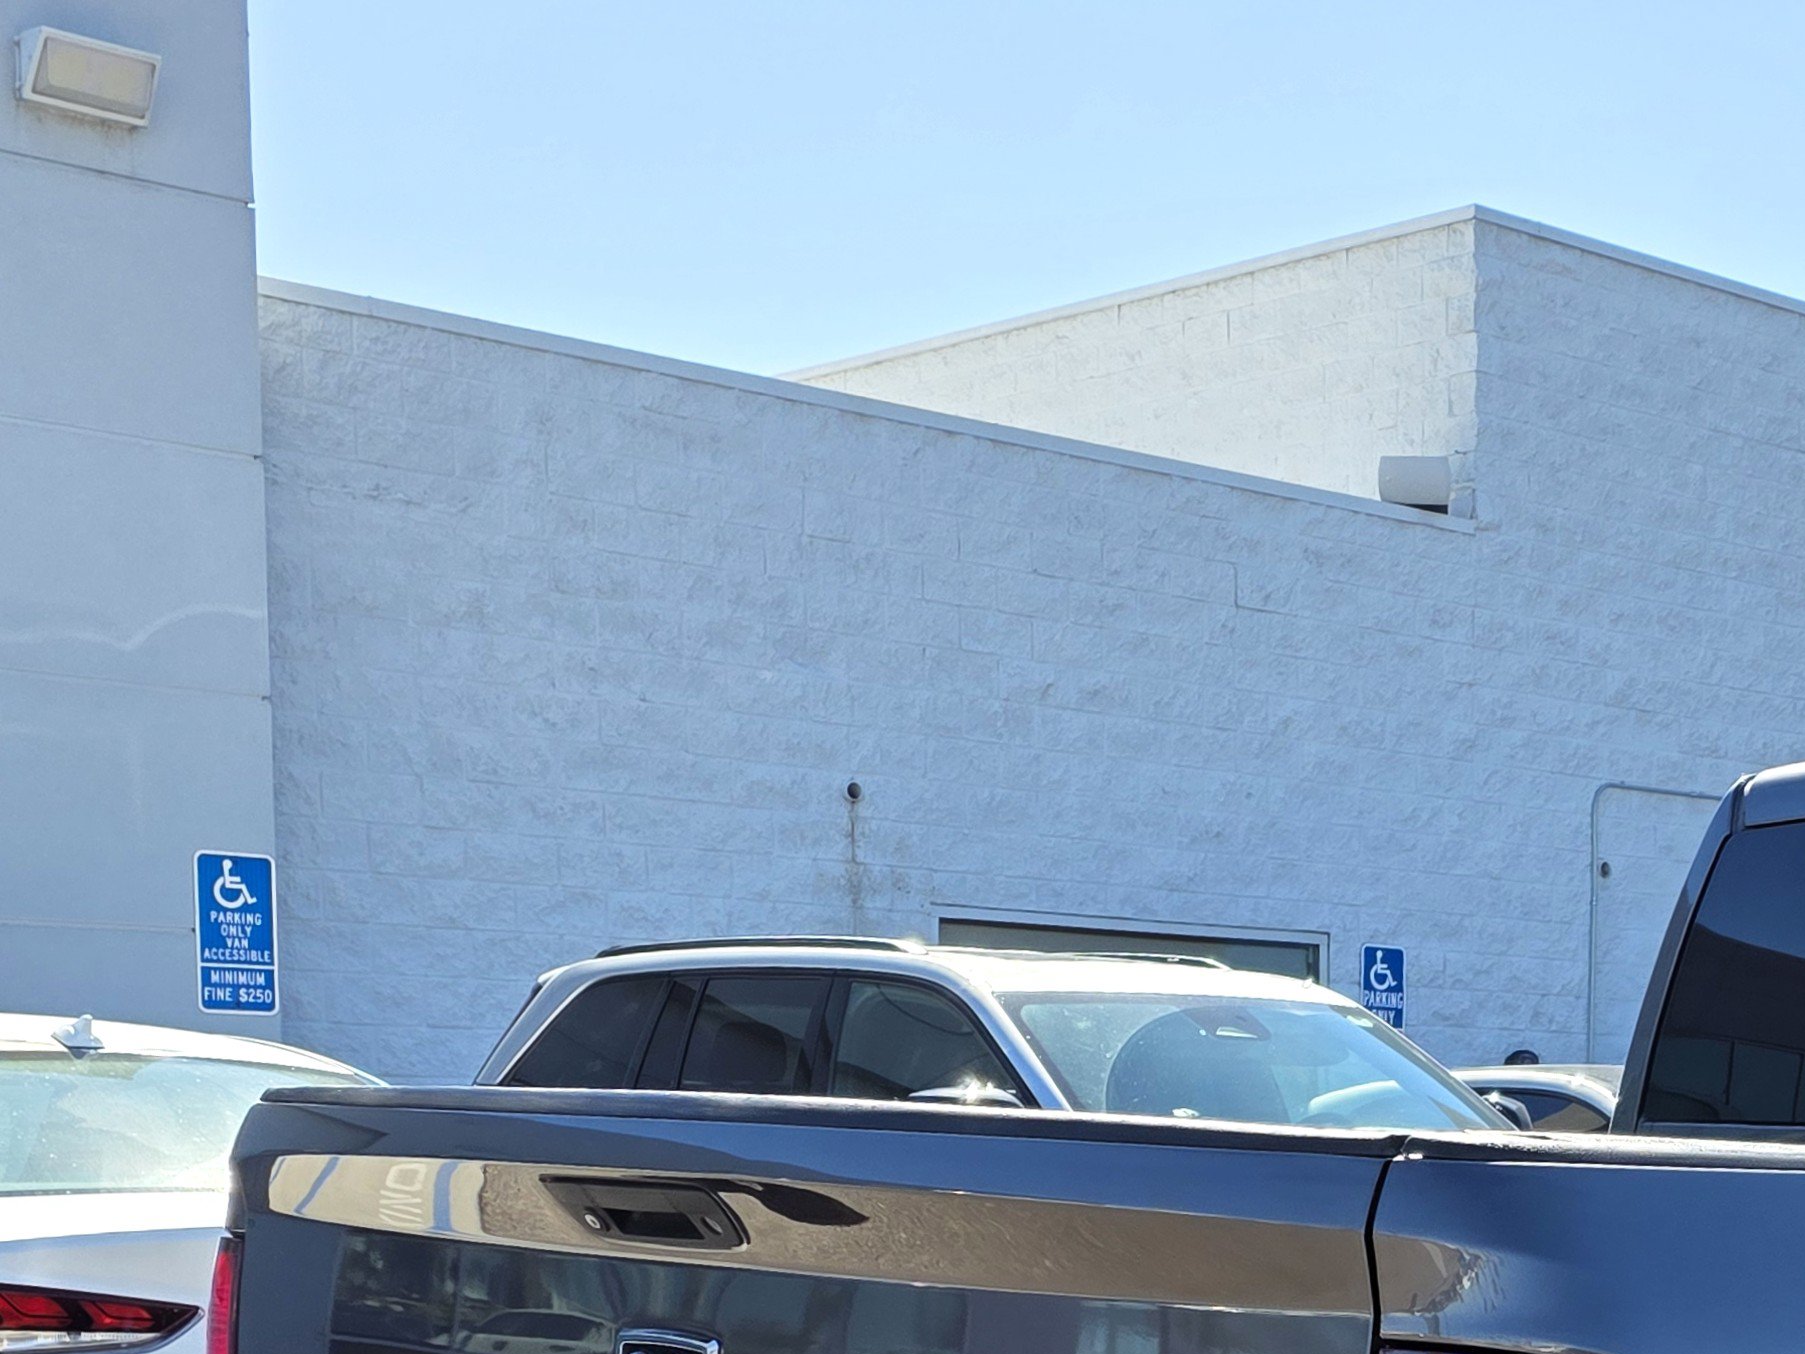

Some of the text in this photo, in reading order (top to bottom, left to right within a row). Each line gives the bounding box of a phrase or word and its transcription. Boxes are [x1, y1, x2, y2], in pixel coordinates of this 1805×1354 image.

[210, 911, 262, 925] PARKING
[221, 925, 252, 937] ONLY
[226, 938, 248, 949] VAN
[203, 948, 271, 962] ACCESSIBLE
[211, 970, 265, 986] MINIMUM
[204, 987, 272, 1003] FINE $250
[1363, 990, 1403, 1009] PARKING
